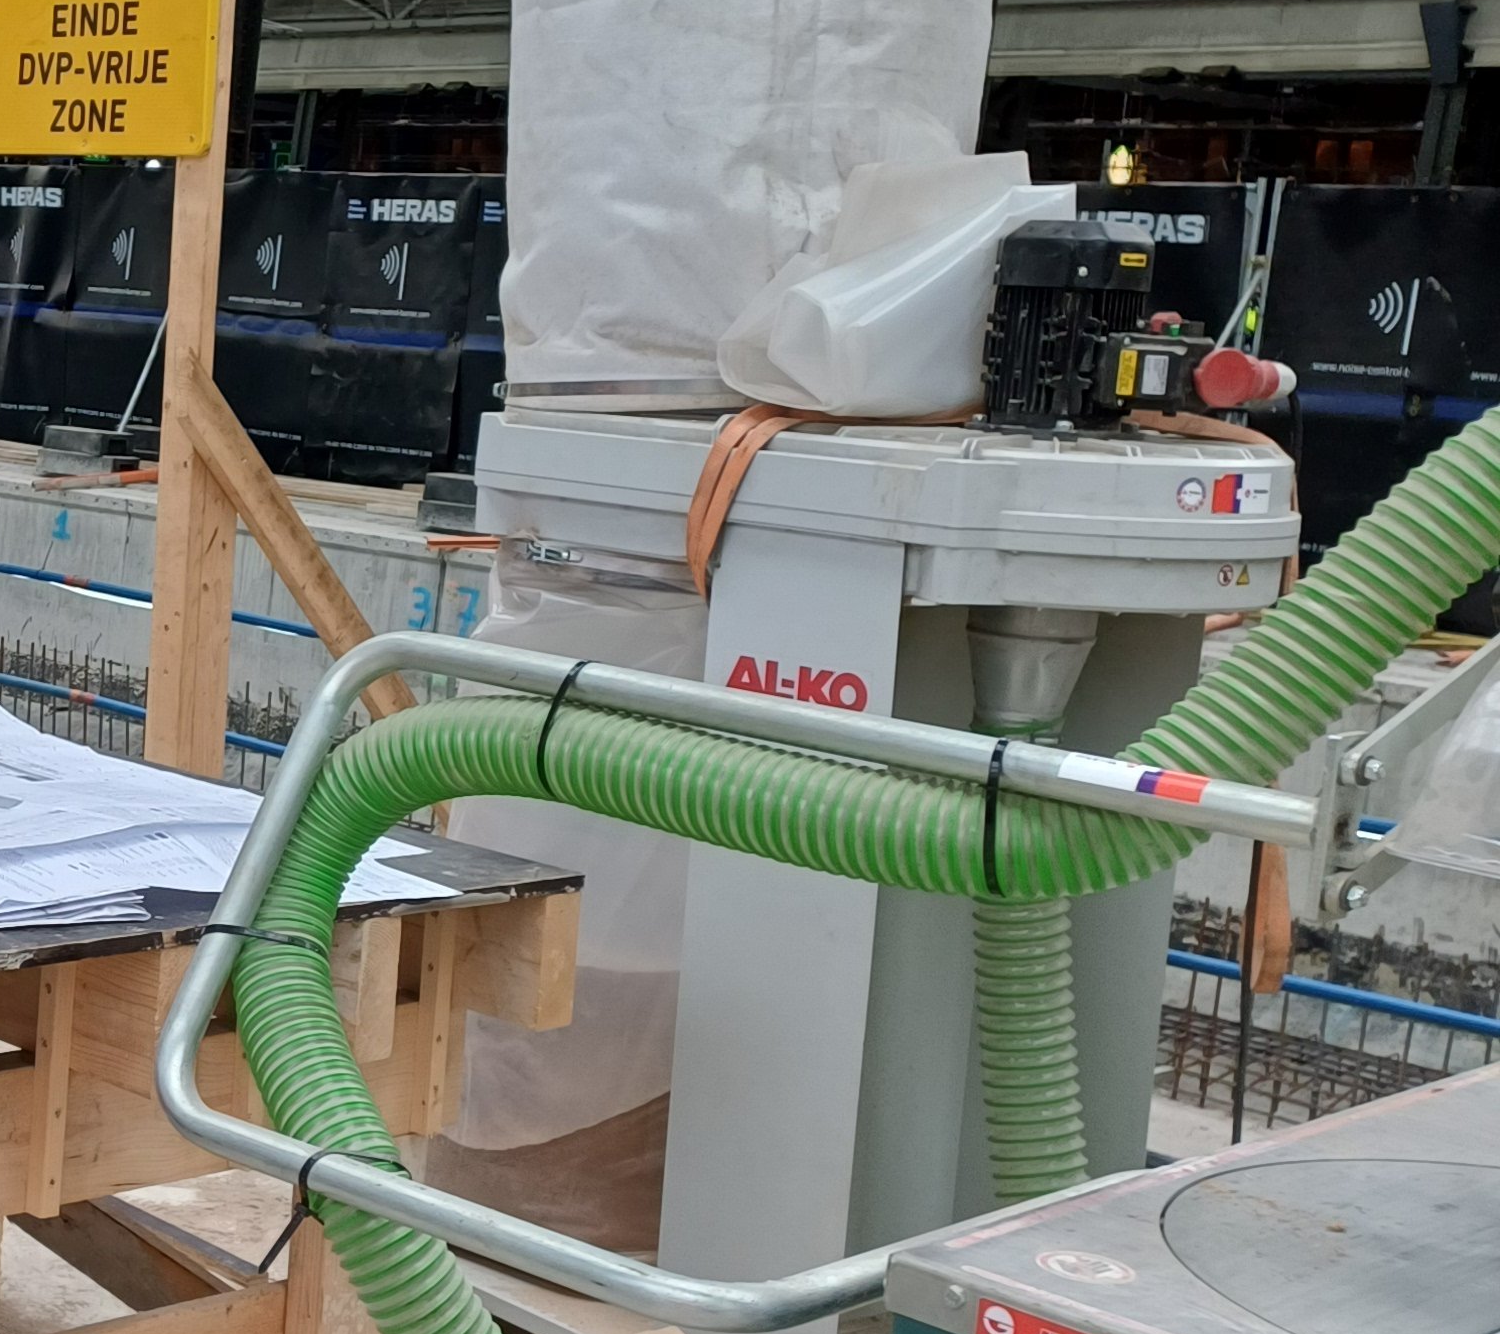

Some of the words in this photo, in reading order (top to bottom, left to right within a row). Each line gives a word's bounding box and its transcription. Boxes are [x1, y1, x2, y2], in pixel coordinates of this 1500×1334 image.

[51, 1, 140, 38] EINDE
[18, 49, 170, 86] DVP-VRIJE
[49, 99, 128, 133] ZONE
[0, 186, 63, 208] HERAS
[370, 198, 457, 223] HERAS
[51, 509, 71, 541] 1
[725, 655, 868, 712] AL-KO
